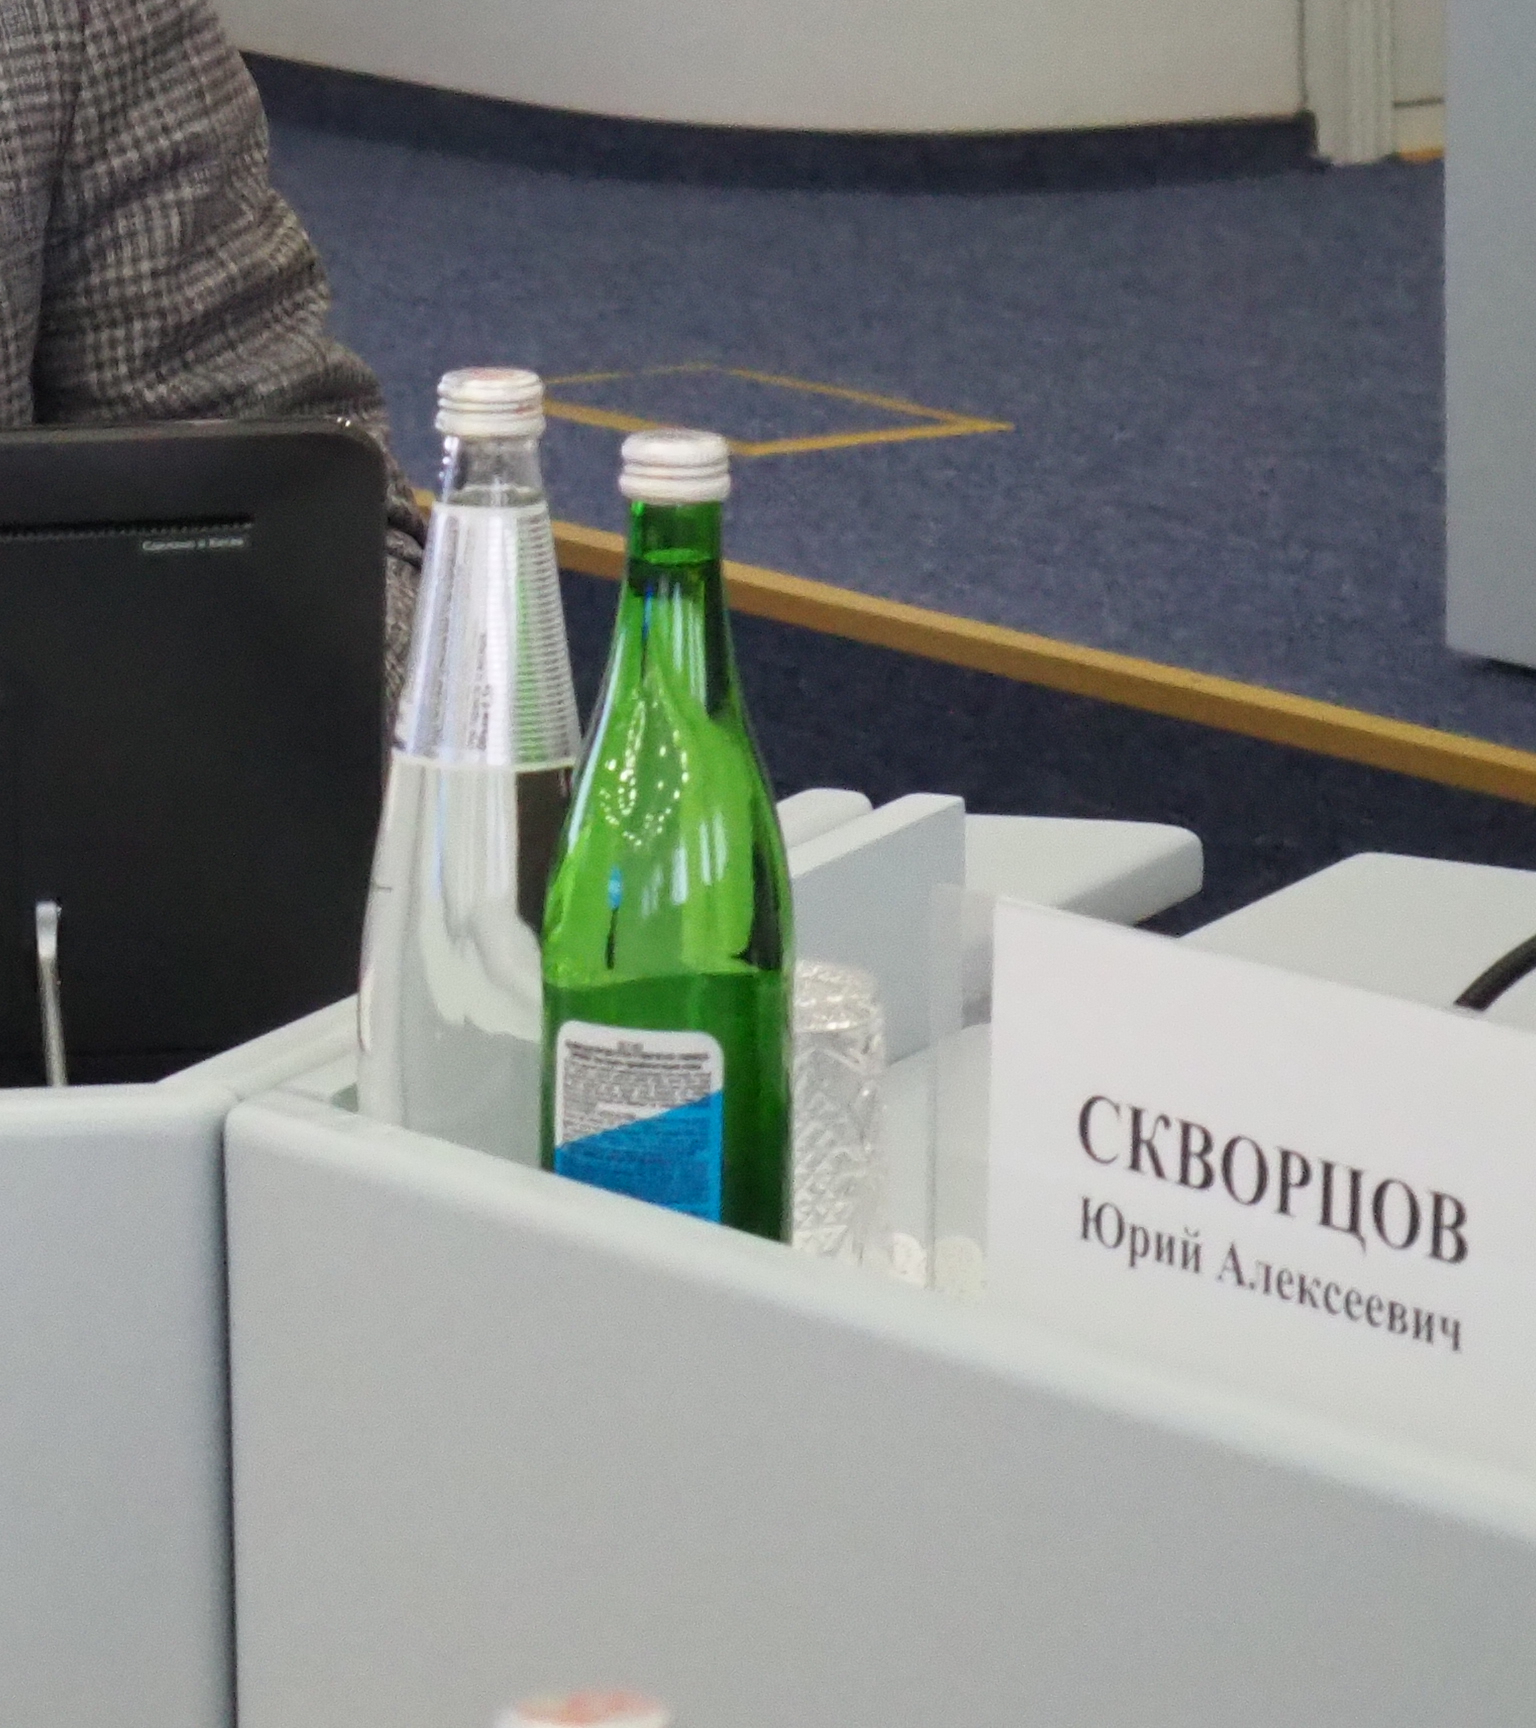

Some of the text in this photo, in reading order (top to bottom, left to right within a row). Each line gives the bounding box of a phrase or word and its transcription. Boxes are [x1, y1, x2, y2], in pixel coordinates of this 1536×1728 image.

[1078, 1094, 1469, 1265] СКВОРЦОВ
[1080, 1197, 1462, 1353] Юрий Алексеевич
